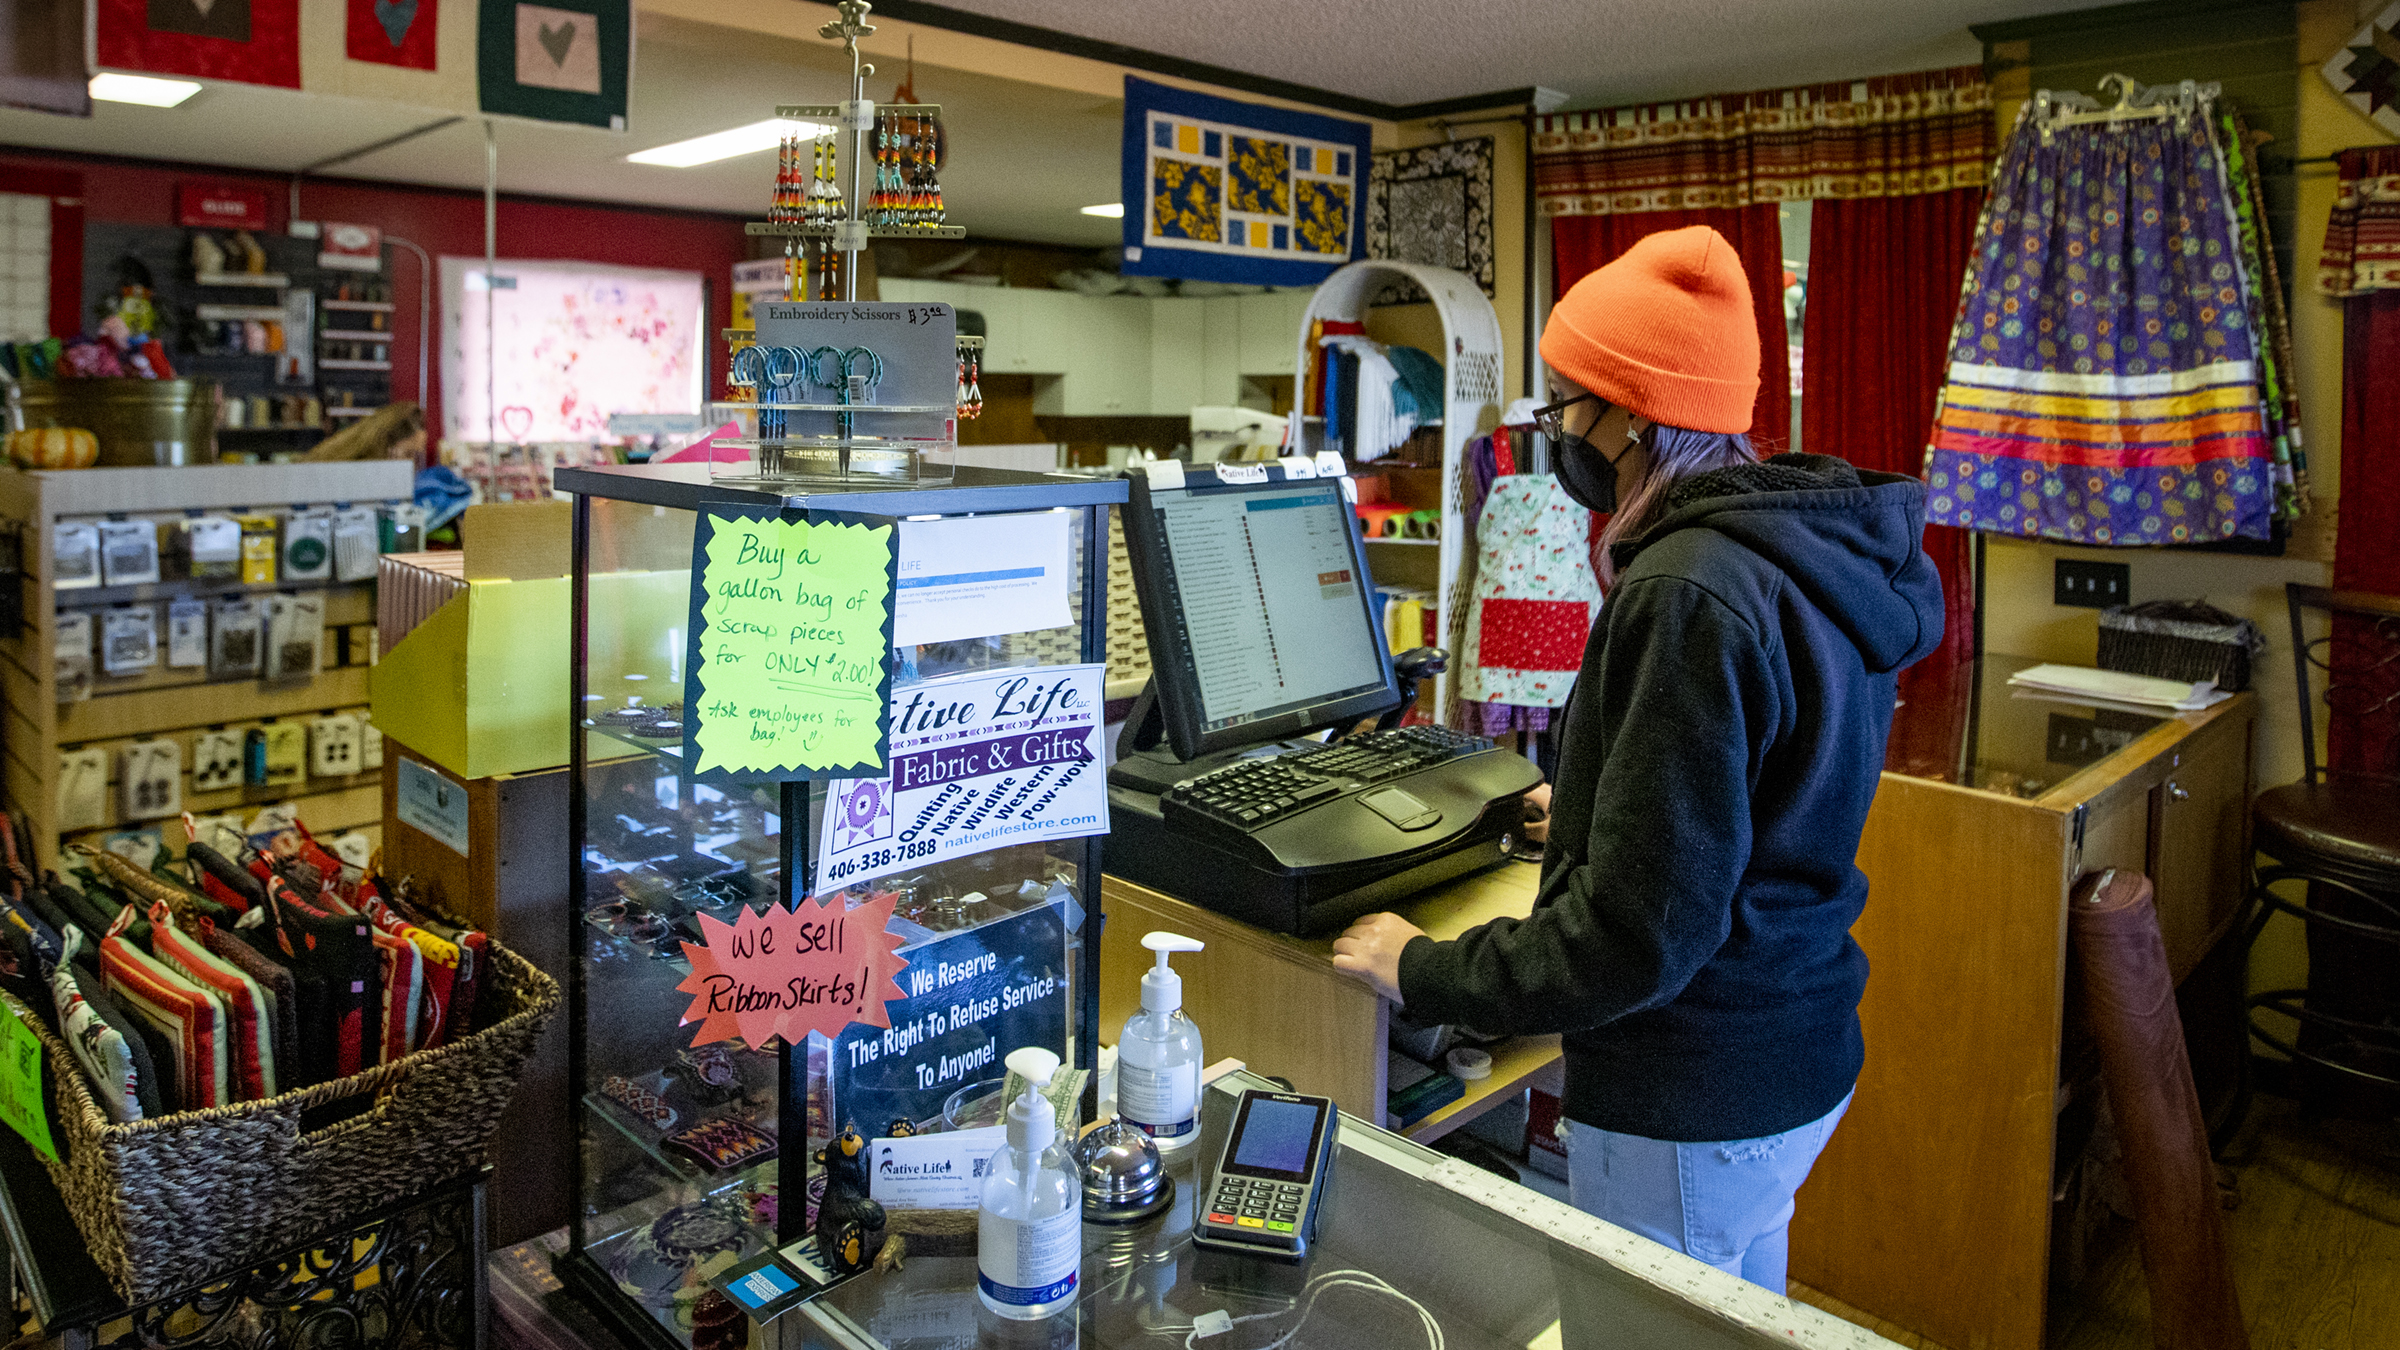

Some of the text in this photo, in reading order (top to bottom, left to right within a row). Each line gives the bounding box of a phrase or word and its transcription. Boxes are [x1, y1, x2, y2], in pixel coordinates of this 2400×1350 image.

[769, 306, 849, 324] Embroidery
[851, 307, 900, 320] Scissors
[737, 533, 821, 580] Buy a
[901, 560, 922, 572] LIFE
[716, 577, 869, 623] gallon bag of
[790, 622, 845, 645] pieces
[716, 644, 746, 665] for
[765, 652, 820, 677] ONLY
[708, 700, 858, 733] Ask employees for
[889, 692, 976, 738] tive
[991, 676, 1078, 730] Life
[750, 721, 785, 748] bag!
[902, 731, 1083, 788] Fabric & Gifts
[960, 775, 1017, 832] Wildlife
[994, 764, 1055, 821] Western
[1020, 754, 1094, 821] Pow-wow
[898, 781, 963, 844] Quilting
[930, 787, 980, 837] Native
[944, 813, 1097, 849] nativelifestore.com
[828, 838, 937, 882] 406-338-7888
[702, 966, 869, 1014] Ribbon Skirts!
[910, 951, 997, 998] We Reserve
[848, 976, 1054, 1068] The Right To Refuse Service
[916, 1036, 996, 1090] To Anyone!
[1272, 1094, 1300, 1102] Verifone
[883, 1161, 946, 1174] Native Life
[747, 1280, 774, 1301] EXPRESS
[751, 1271, 781, 1296] AMERICAN
